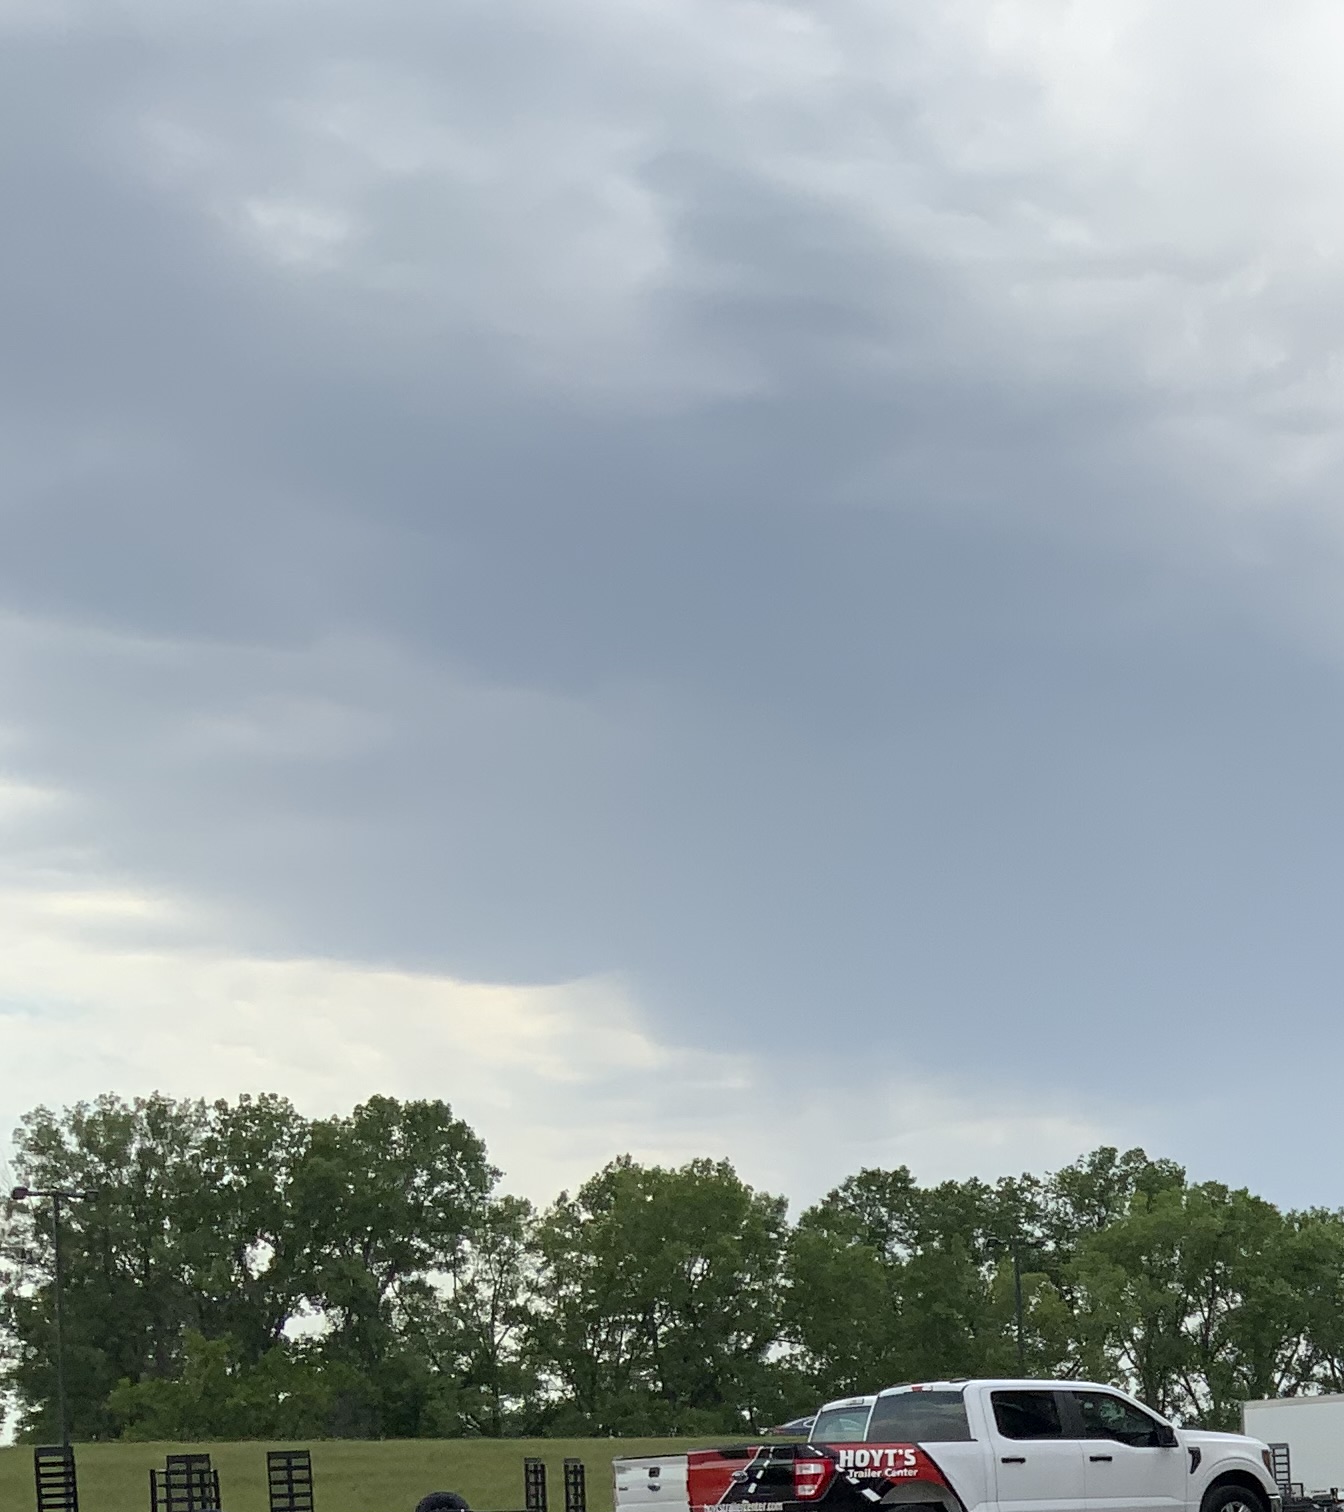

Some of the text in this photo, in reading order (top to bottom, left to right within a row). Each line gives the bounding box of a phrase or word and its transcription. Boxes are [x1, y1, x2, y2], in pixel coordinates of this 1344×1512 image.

[839, 1448, 917, 1467] HOYT'S
[847, 1467, 919, 1478] Trailer Center
